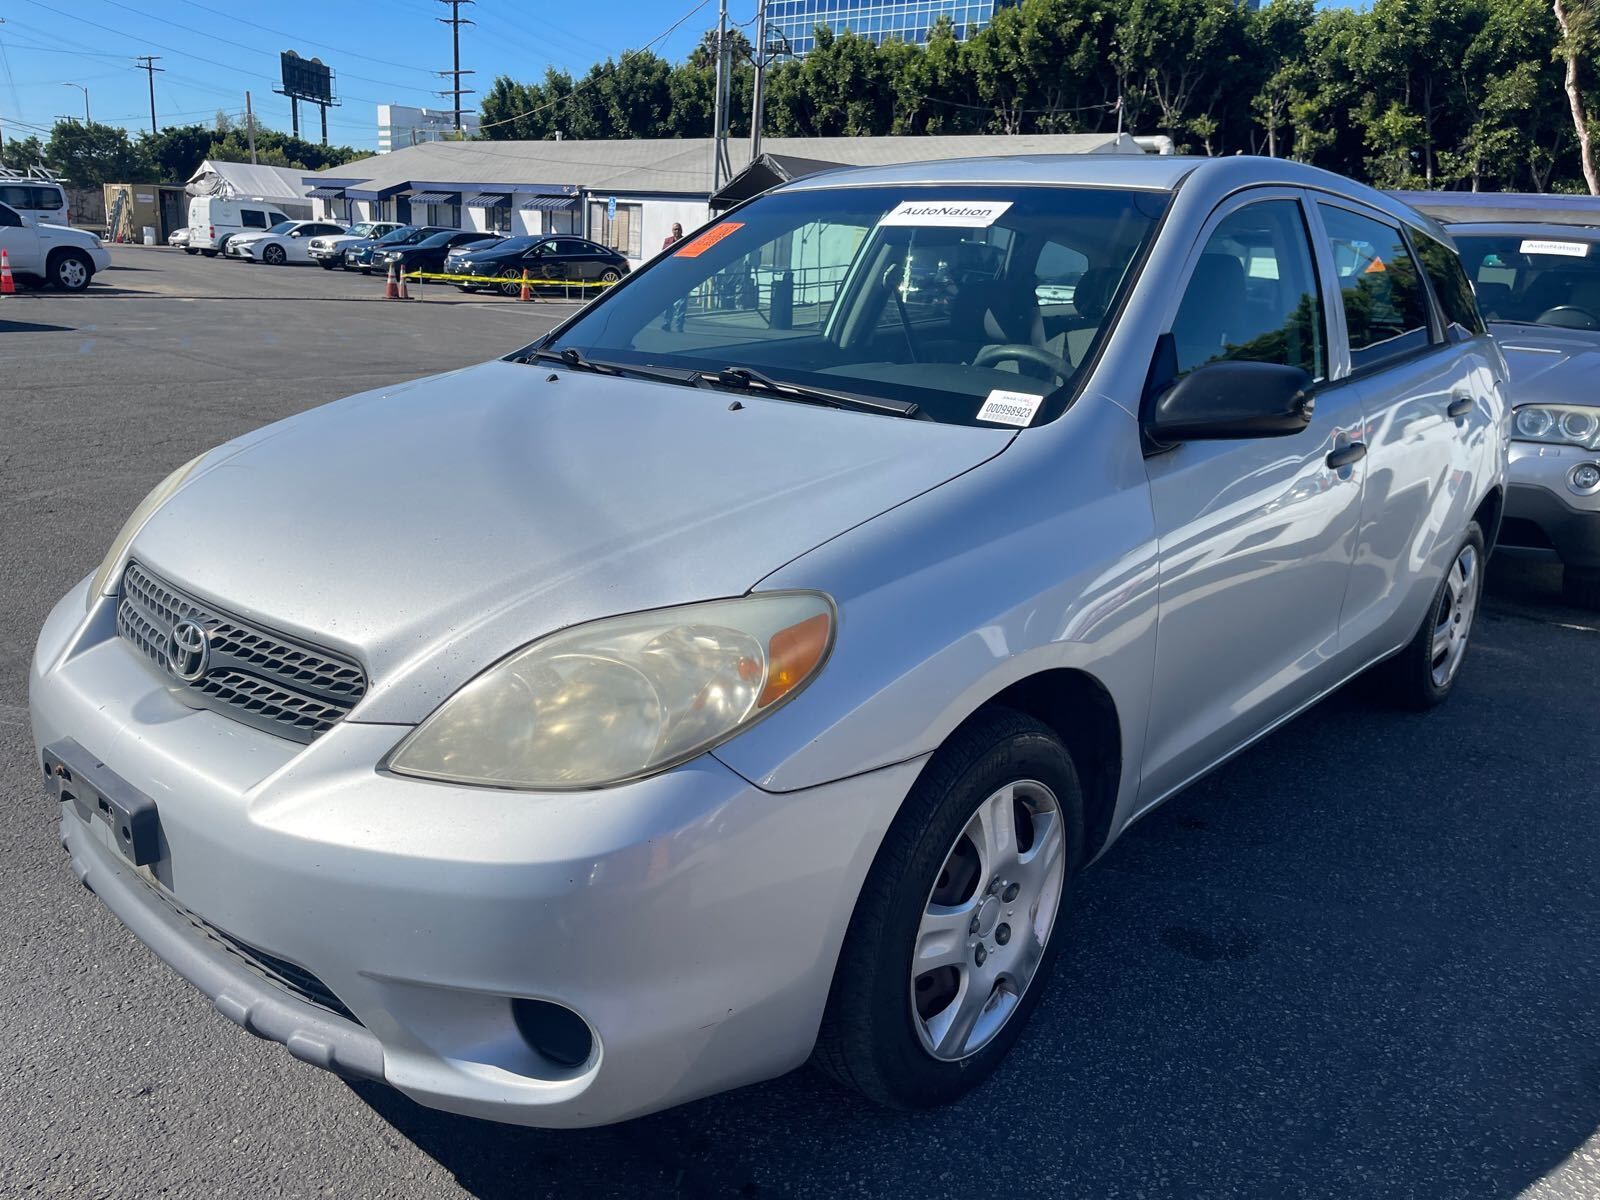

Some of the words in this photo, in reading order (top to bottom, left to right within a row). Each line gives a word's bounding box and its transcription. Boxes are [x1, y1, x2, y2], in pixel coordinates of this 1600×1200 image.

[900, 207, 992, 216] AutoNation
[1528, 243, 1581, 252] AutoNation
[986, 403, 1032, 418] 000998923
